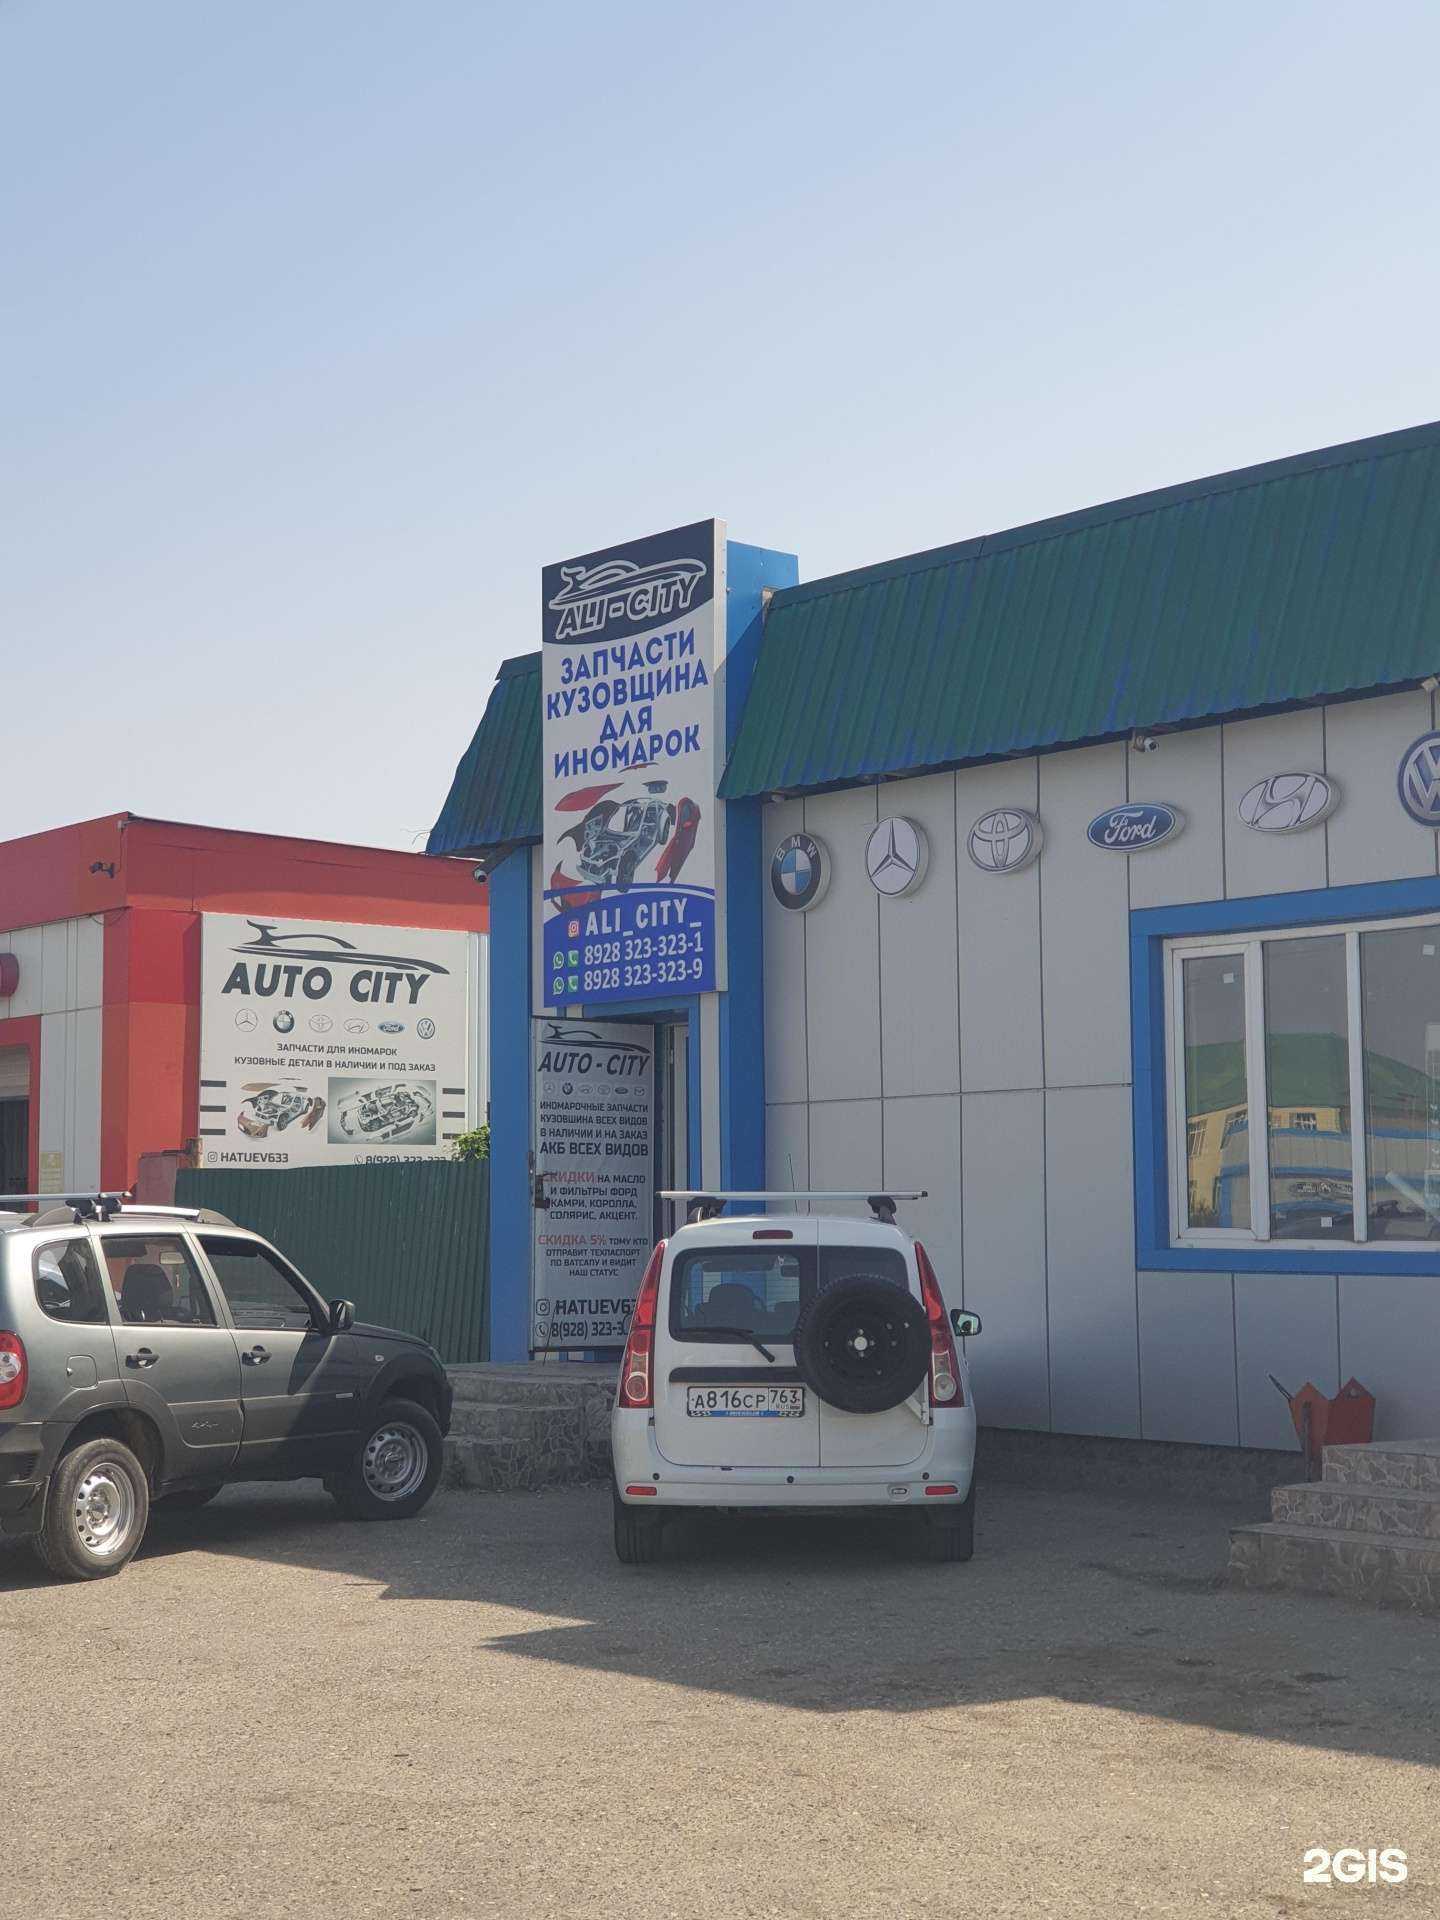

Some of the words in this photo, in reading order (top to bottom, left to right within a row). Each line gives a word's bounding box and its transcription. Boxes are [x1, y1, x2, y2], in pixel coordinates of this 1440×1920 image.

[556, 573, 700, 640] ALI-CITY
[560, 627, 695, 685] ЗАПЧАСТИ
[547, 658, 709, 720] КУЗОВЩИНА
[599, 705, 653, 744] ДЛЯ
[554, 724, 701, 779] ИНОМАРОК
[1104, 810, 1158, 844] Ford
[775, 836, 817, 862] BMW
[584, 942, 621, 965] 8928
[624, 931, 704, 961] 323-323-1
[221, 962, 333, 1000] AUTO
[350, 970, 431, 1004] CITY
[584, 967, 620, 991] 8928
[624, 958, 703, 987] 323-323-9
[277, 1043, 325, 1054] ЗАПЧАСТИ
[327, 1045, 346, 1055] ДЛЯ
[348, 1047, 398, 1057] ИНОМАРОК
[234, 1056, 286, 1066] КУЗОВНЫЕ
[288, 1058, 324, 1068] ДЕТАЛИ
[326, 1060, 333, 1068] В
[335, 1060, 377, 1070] НАЛИЧИИ
[379, 1062, 386, 1070] И
[388, 1063, 406, 1072] ПОД
[408, 1064, 436, 1073] ЗАКАЗ
[538, 1051, 593, 1074] AUTO
[606, 1054, 650, 1076] CITY
[539, 1101, 605, 1111] ИНОМАРОЧНЫЕ
[607, 1103, 648, 1113] ЗАПЧАСТИ
[596, 1115, 617, 1125] ВСЕХ
[620, 1116, 648, 1126] ВИДОВ
[540, 1128, 546, 1137] В
[549, 1128, 593, 1138] НАЛИЧИИ
[596, 1129, 602, 1138] И
[605, 1129, 617, 1139] НА
[619, 1130, 648, 1140] ЗАКАЗ
[220, 1152, 289, 1163] HATUEV633
[539, 1141, 566, 1155] АКБ
[569, 1142, 602, 1156] ВСЕХ
[605, 1143, 648, 1158] ВИДОВ
[597, 1174, 610, 1183] НА
[613, 1174, 646, 1184] МАСЛО
[550, 1187, 557, 1195] И
[560, 1187, 607, 1196] ФИЛЬТРЫ
[610, 1187, 638, 1198] ФОРД
[538, 1235, 587, 1247] СКИДКА
[591, 1235, 607, 1246] 5%
[609, 1238, 630, 1246] ТОМУ
[632, 1238, 649, 1246] КТО
[546, 1249, 587, 1257] ОТПРАВИТ
[550, 1259, 562, 1267] ПО
[602, 1259, 608, 1267] И
[610, 1259, 636, 1268] ВИДИТ
[569, 1269, 588, 1277] НАШ
[590, 1269, 618, 1277] СТАТУС
[551, 1320, 588, 1340] 8(928)
[770, 1389, 797, 1404] 763
